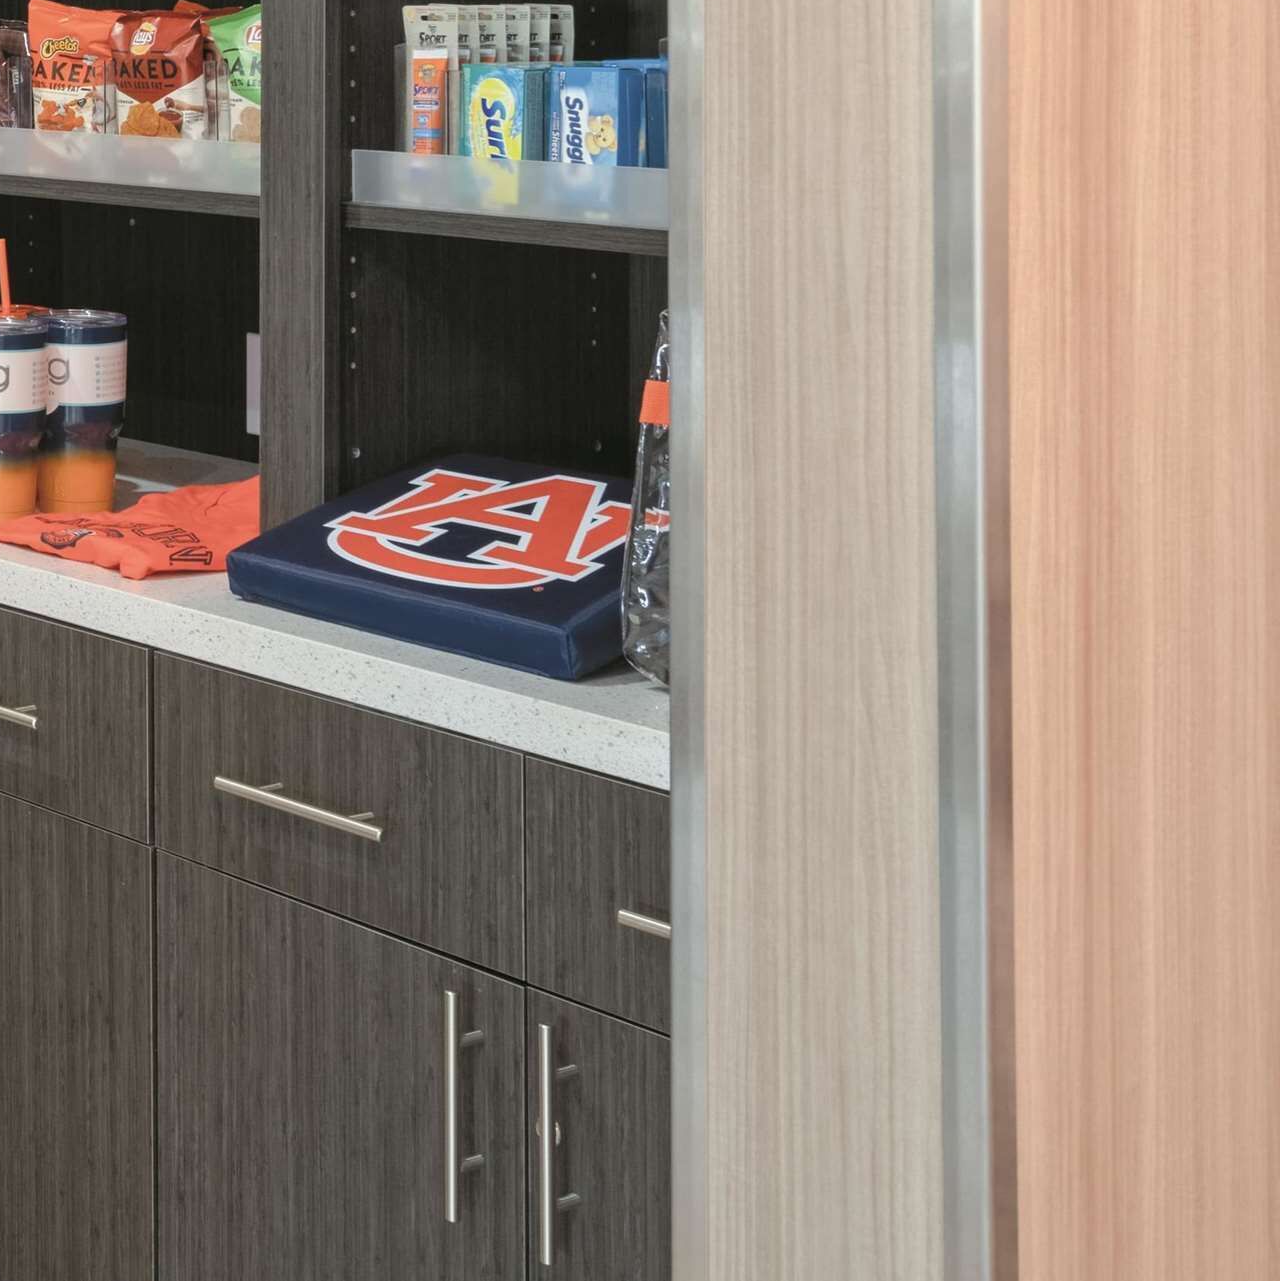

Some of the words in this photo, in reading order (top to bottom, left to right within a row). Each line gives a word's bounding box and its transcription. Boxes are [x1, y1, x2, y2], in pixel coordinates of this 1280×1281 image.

[419, 32, 447, 44] SPORT
[42, 36, 79, 59] Cheetos
[49, 81, 64, 92] LESS
[64, 84, 80, 93] FAT
[565, 95, 587, 165] Snuggl
